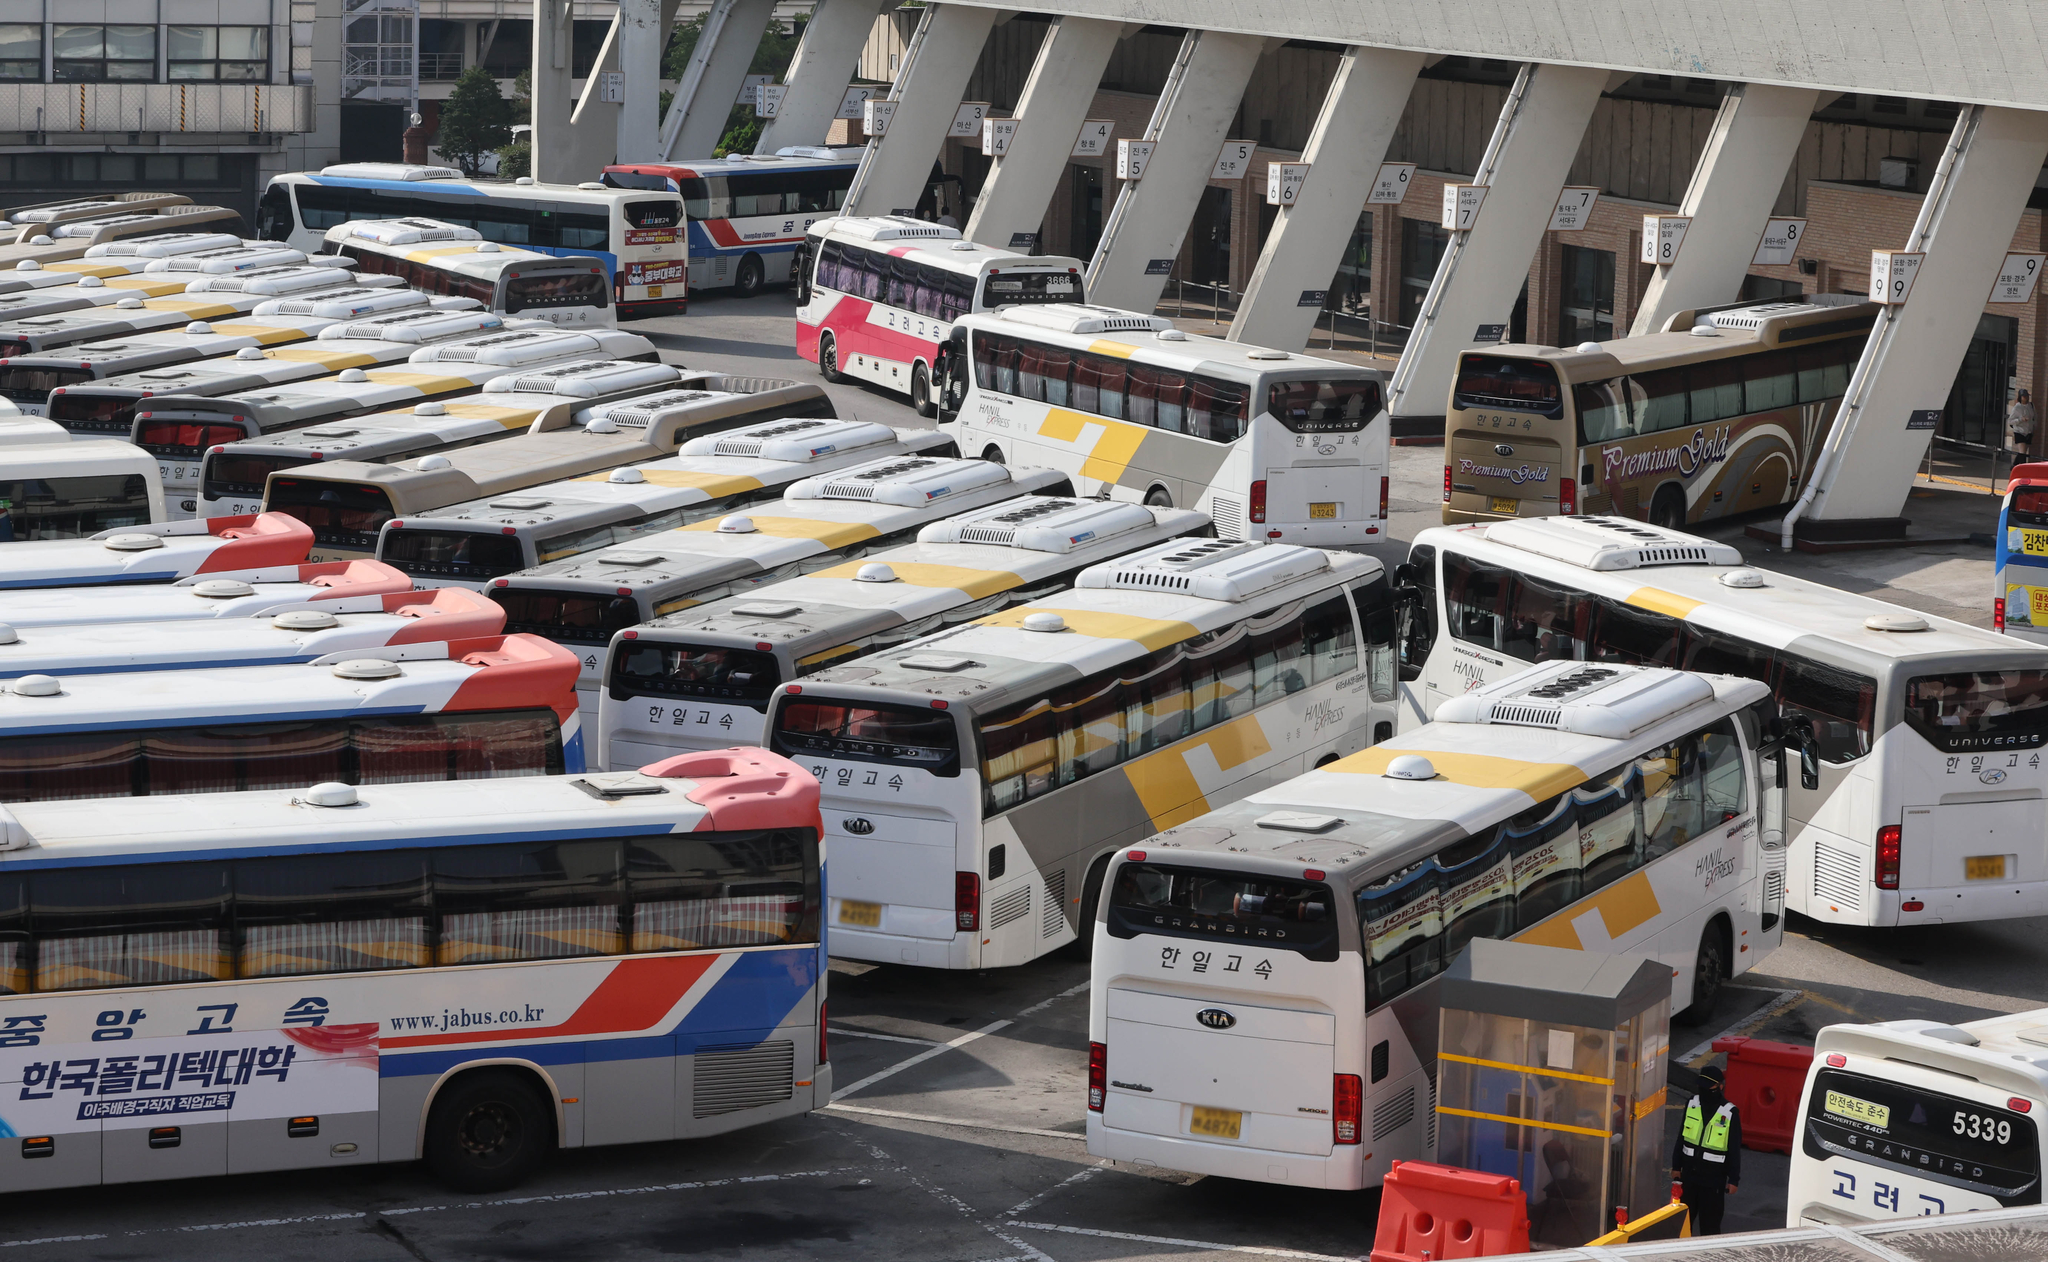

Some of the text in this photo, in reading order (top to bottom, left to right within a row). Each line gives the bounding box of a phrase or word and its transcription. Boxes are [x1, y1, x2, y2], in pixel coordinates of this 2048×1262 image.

[610, 89, 615, 99] 1
[861, 91, 869, 100] 2
[767, 103, 774, 113] 2
[876, 106, 891, 114] 마산
[974, 108, 982, 118] 3
[877, 120, 884, 131] 3
[997, 126, 1012, 134] 창원
[1098, 125, 1106, 136] 4
[996, 139, 1003, 150] 4
[1081, 140, 1095, 148] 창원
[1133, 148, 1149, 156] 진주
[1239, 147, 1247, 159] 5
[1132, 162, 1140, 174] 5
[1220, 162, 1236, 170] 진주
[1399, 169, 1407, 182] 6
[1271, 186, 1276, 198] 6
[1284, 186, 1292, 199] 6
[1581, 193, 1589, 207] 7
[1447, 209, 1452, 222] 7
[1462, 210, 1470, 224] 7
[1788, 224, 1796, 239] 8
[1647, 242, 1652, 256] 8
[1663, 243, 1671, 258] 8
[645, 266, 682, 282] 중부대학교
[2027, 259, 2036, 276] 9
[1047, 276, 1070, 284] 3666
[1876, 279, 1883, 295] 9
[1895, 280, 1904, 297] 9
[889, 312, 939, 340] 고려고속
[979, 404, 1000, 416] HANIL
[986, 415, 1010, 428] EXPRESS
[1477, 414, 1532, 431] 한일고속
[1296, 435, 1360, 447] 한일고속
[160, 466, 199, 479] 한일고
[1497, 503, 1514, 512] 5024
[1453, 659, 1484, 682] HANIL
[644, 682, 743, 696] GRANBIRD
[1305, 698, 1331, 722] HANIL
[650, 705, 733, 730] 한일고속
[1314, 706, 1345, 731] EXPRESS
[808, 738, 916, 756] GRANBIRD
[1950, 735, 2039, 746] UNIVERSE
[1946, 753, 2040, 774] 한일고속
[812, 765, 903, 792] 한일고속
[845, 820, 872, 832] KIA
[1695, 848, 1722, 877] HANIL
[1705, 857, 1735, 888] EXPRESS
[1154, 916, 1286, 938] GRANBIRD
[1161, 946, 1272, 980] 한일고속
[0, 996, 329, 1048] 중앙고속
[390, 1003, 545, 1032] www.jabus.co.kr
[1202, 1012, 1229, 1026] KIA
[19, 1045, 296, 1100] 한국폴리텍대학
[84, 1093, 230, 1117] 이주배경구직자 직업교육
[1829, 1092, 1864, 1114] 안전속도
[1868, 1104, 1885, 1119] 준수
[1823, 1112, 1862, 1129] POWERTEC
[1953, 1111, 2011, 1145] 5339
[1848, 1134, 1983, 1177] GRANBIRD
[1832, 1170, 1946, 1216] 고려고
